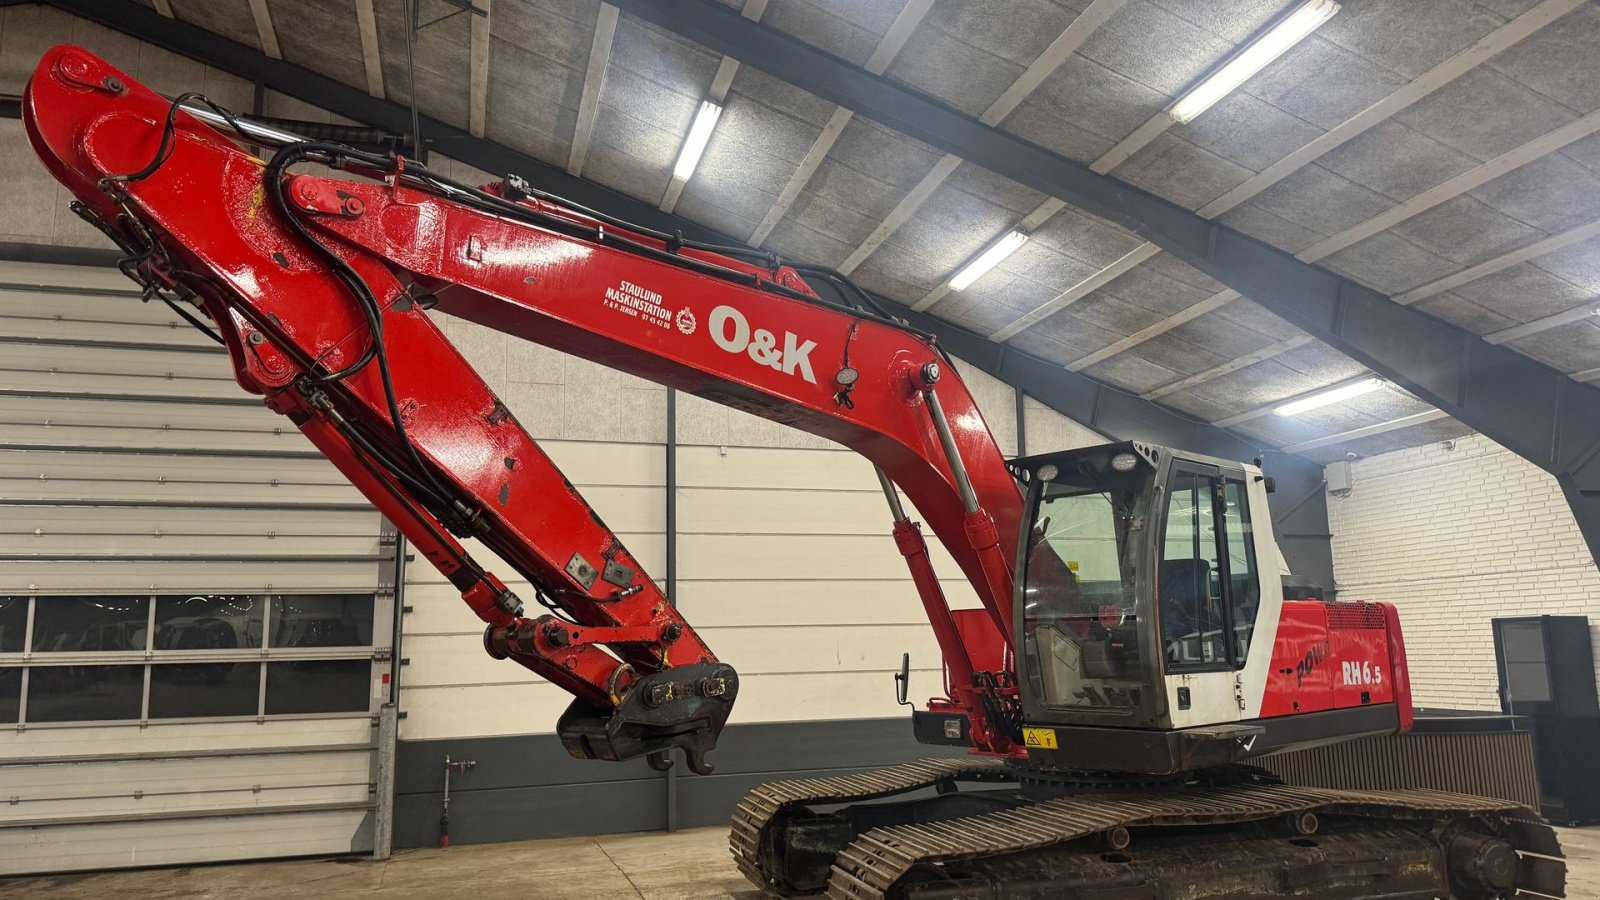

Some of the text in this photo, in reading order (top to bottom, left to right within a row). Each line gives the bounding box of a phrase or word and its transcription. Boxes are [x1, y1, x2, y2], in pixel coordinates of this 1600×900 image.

[605, 287, 672, 321] MASKINSTATION
[620, 280, 663, 306] STAULUND
[620, 305, 638, 317] JENSEN
[708, 305, 818, 384] O&K
